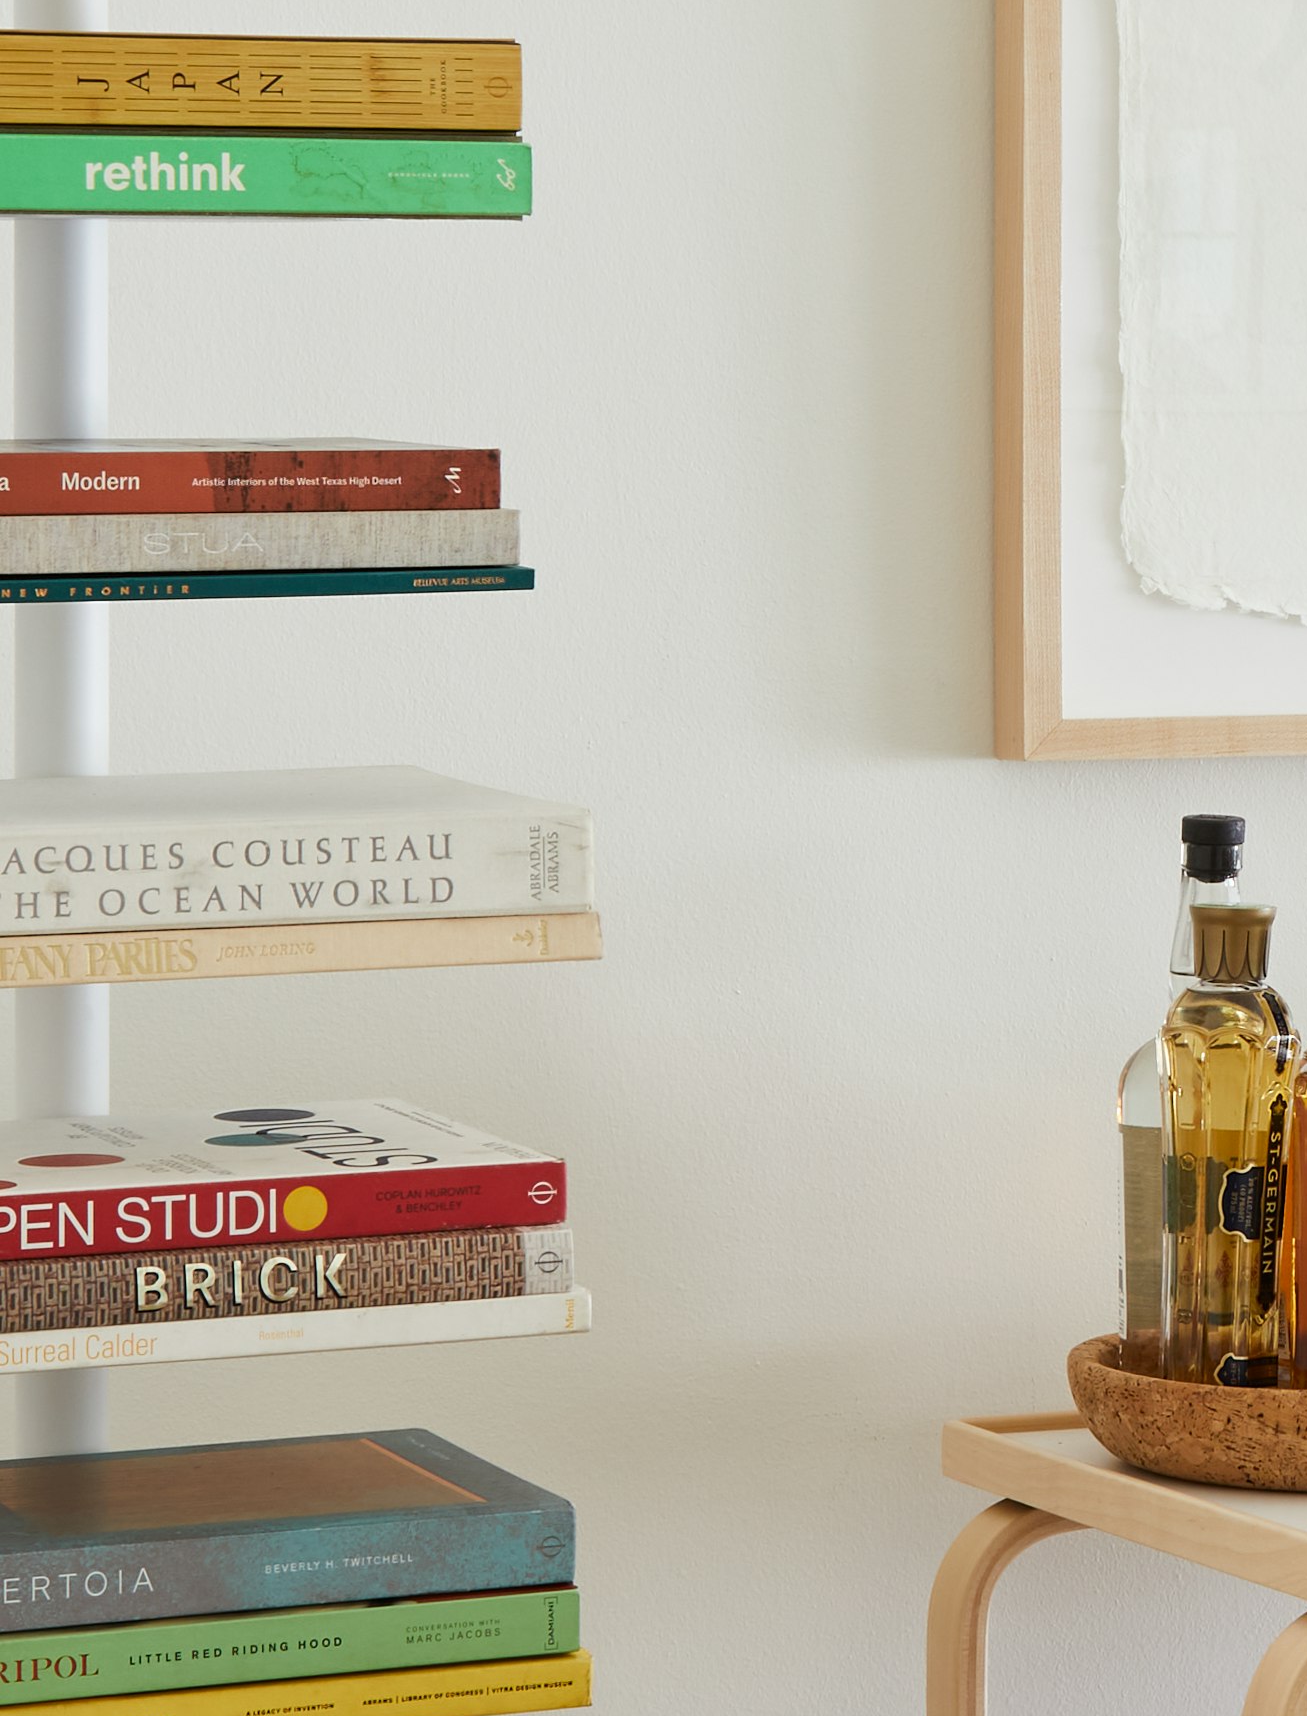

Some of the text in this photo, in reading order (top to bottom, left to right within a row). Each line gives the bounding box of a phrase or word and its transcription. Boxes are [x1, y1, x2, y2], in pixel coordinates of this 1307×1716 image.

[77, 69, 284, 96] JAPAN
[85, 151, 246, 191] rethink
[61, 470, 402, 491] Modern Artistic Interiors of the West Texas High Desert
[143, 532, 264, 555] STUA
[1, 587, 48, 599] NEW
[212, 834, 452, 868] COUSTEAU
[529, 825, 542, 901] ABRADALE
[547, 832, 559, 893] ABRAMS
[0, 877, 454, 919] HE OCEAN WORLD
[84, 937, 198, 976] PARTIES
[216, 945, 256, 962] JOHN
[259, 942, 316, 957] LORING
[376, 1185, 481, 1201] COPLAN HUROWITZ
[406, 1201, 462, 1213] BENCHLEY
[135, 1253, 348, 1312] BRICK
[0, 1332, 158, 1366] Surreal Calder
[258, 1327, 304, 1341] Rosenthal
[3, 1567, 154, 1604] ERTOIA
[264, 1561, 320, 1574] BEVERLY
[343, 1553, 413, 1567] TWITCHELL
[406, 1620, 475, 1633] CONVERSATION
[406, 1627, 502, 1644] MARC JACOBS
[546, 1599, 557, 1648] DAMIANI
[129, 1650, 183, 1666] LITTLE
[191, 1647, 222, 1660] RED
[231, 1641, 289, 1657] RIDING
[298, 1636, 343, 1651] HOOD
[253, 1708, 281, 1716] LEGACY
[283, 1706, 292, 1714] OF
[294, 1702, 335, 1713] INVENTION
[362, 1697, 393, 1706] ABRAMS
[401, 1694, 432, 1703] LIBRARY
[434, 1692, 443, 1700] OF
[445, 1689, 484, 1699] CONGRESS
[491, 1686, 514, 1694] VITRA
